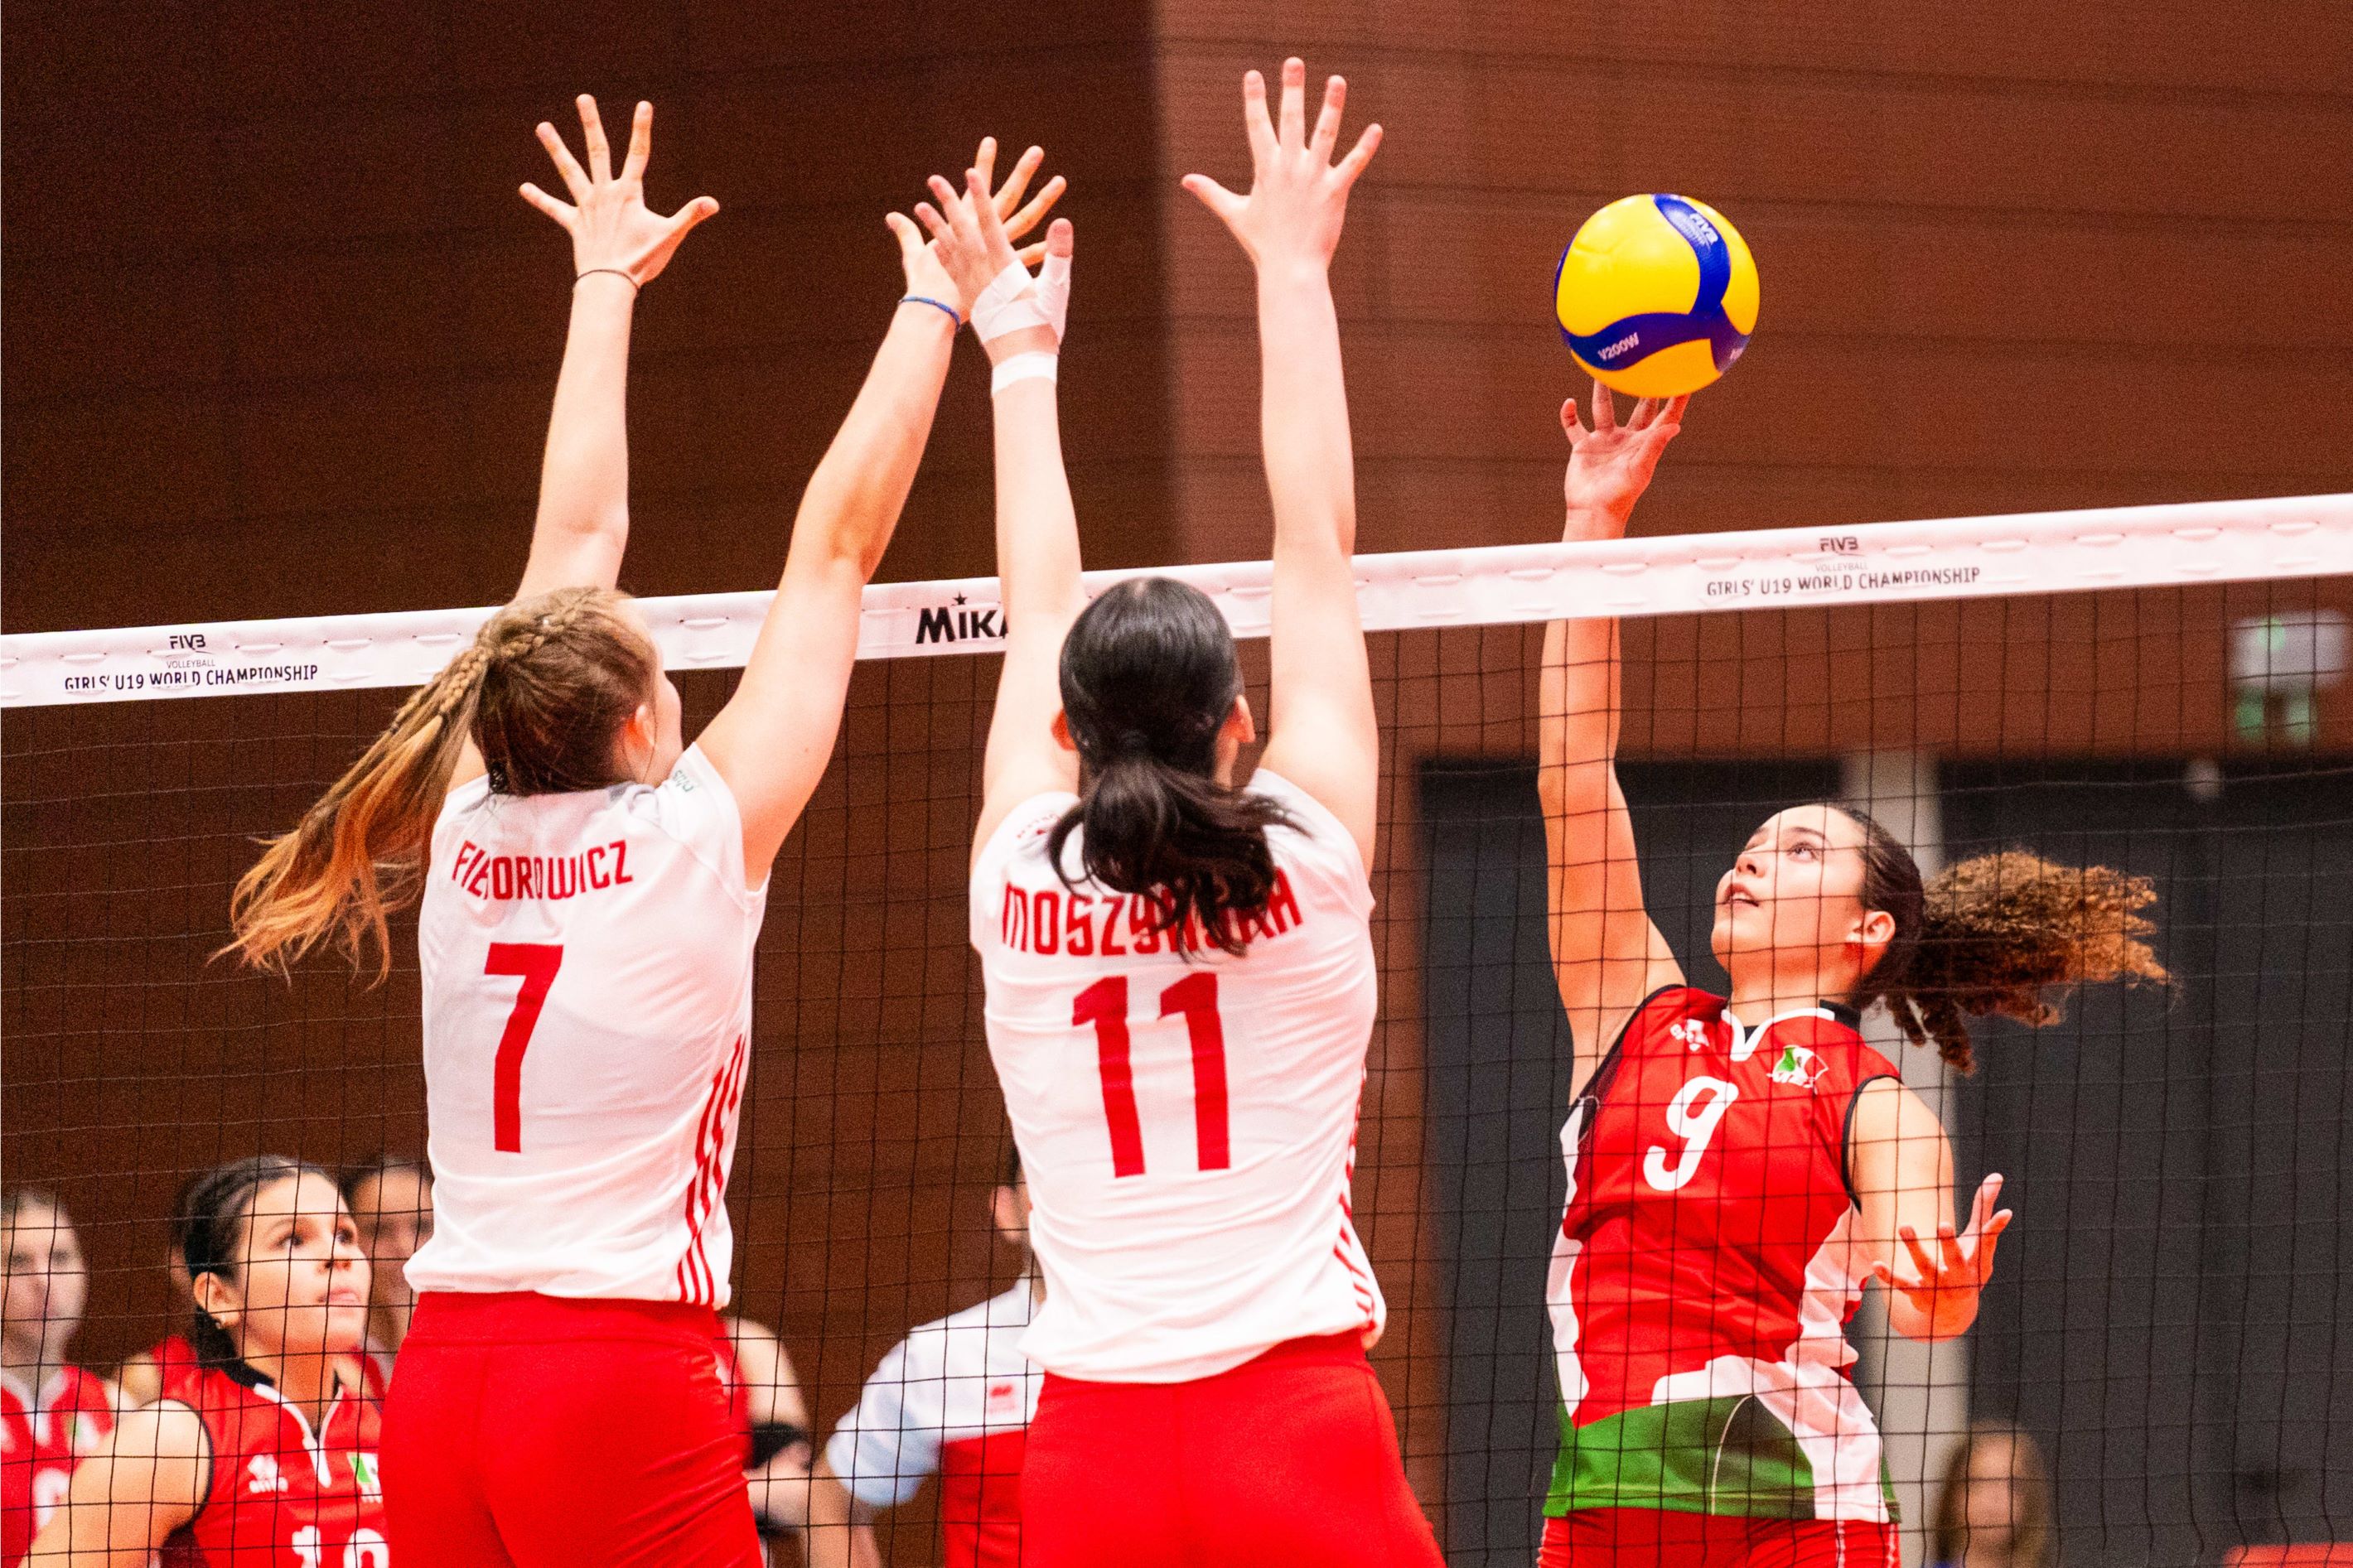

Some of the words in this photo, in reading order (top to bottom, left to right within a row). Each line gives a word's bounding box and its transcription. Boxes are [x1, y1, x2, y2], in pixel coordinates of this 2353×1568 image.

[1597, 332, 1640, 361] V200W
[1820, 537, 1859, 552] FIVB
[1761, 579, 1791, 595] U19
[1798, 575, 1853, 591] WORLD
[1858, 567, 1980, 590] CHAMPIONSHIP
[1815, 562, 1868, 572] VOLLEYBALL
[916, 595, 1008, 644] MIK
[169, 634, 206, 649] FIVB
[115, 673, 144, 689] U19
[150, 670, 201, 686] WORLD
[206, 664, 318, 685] CHAMPIONSHIP
[167, 659, 215, 668] VOLLEYBALL
[452, 839, 633, 900] FIEOROWICZ
[1003, 866, 1303, 956] MOSZYA
[485, 942, 563, 1153] 7
[1072, 972, 1230, 1179] 11
[1643, 1076, 1739, 1191] 9
